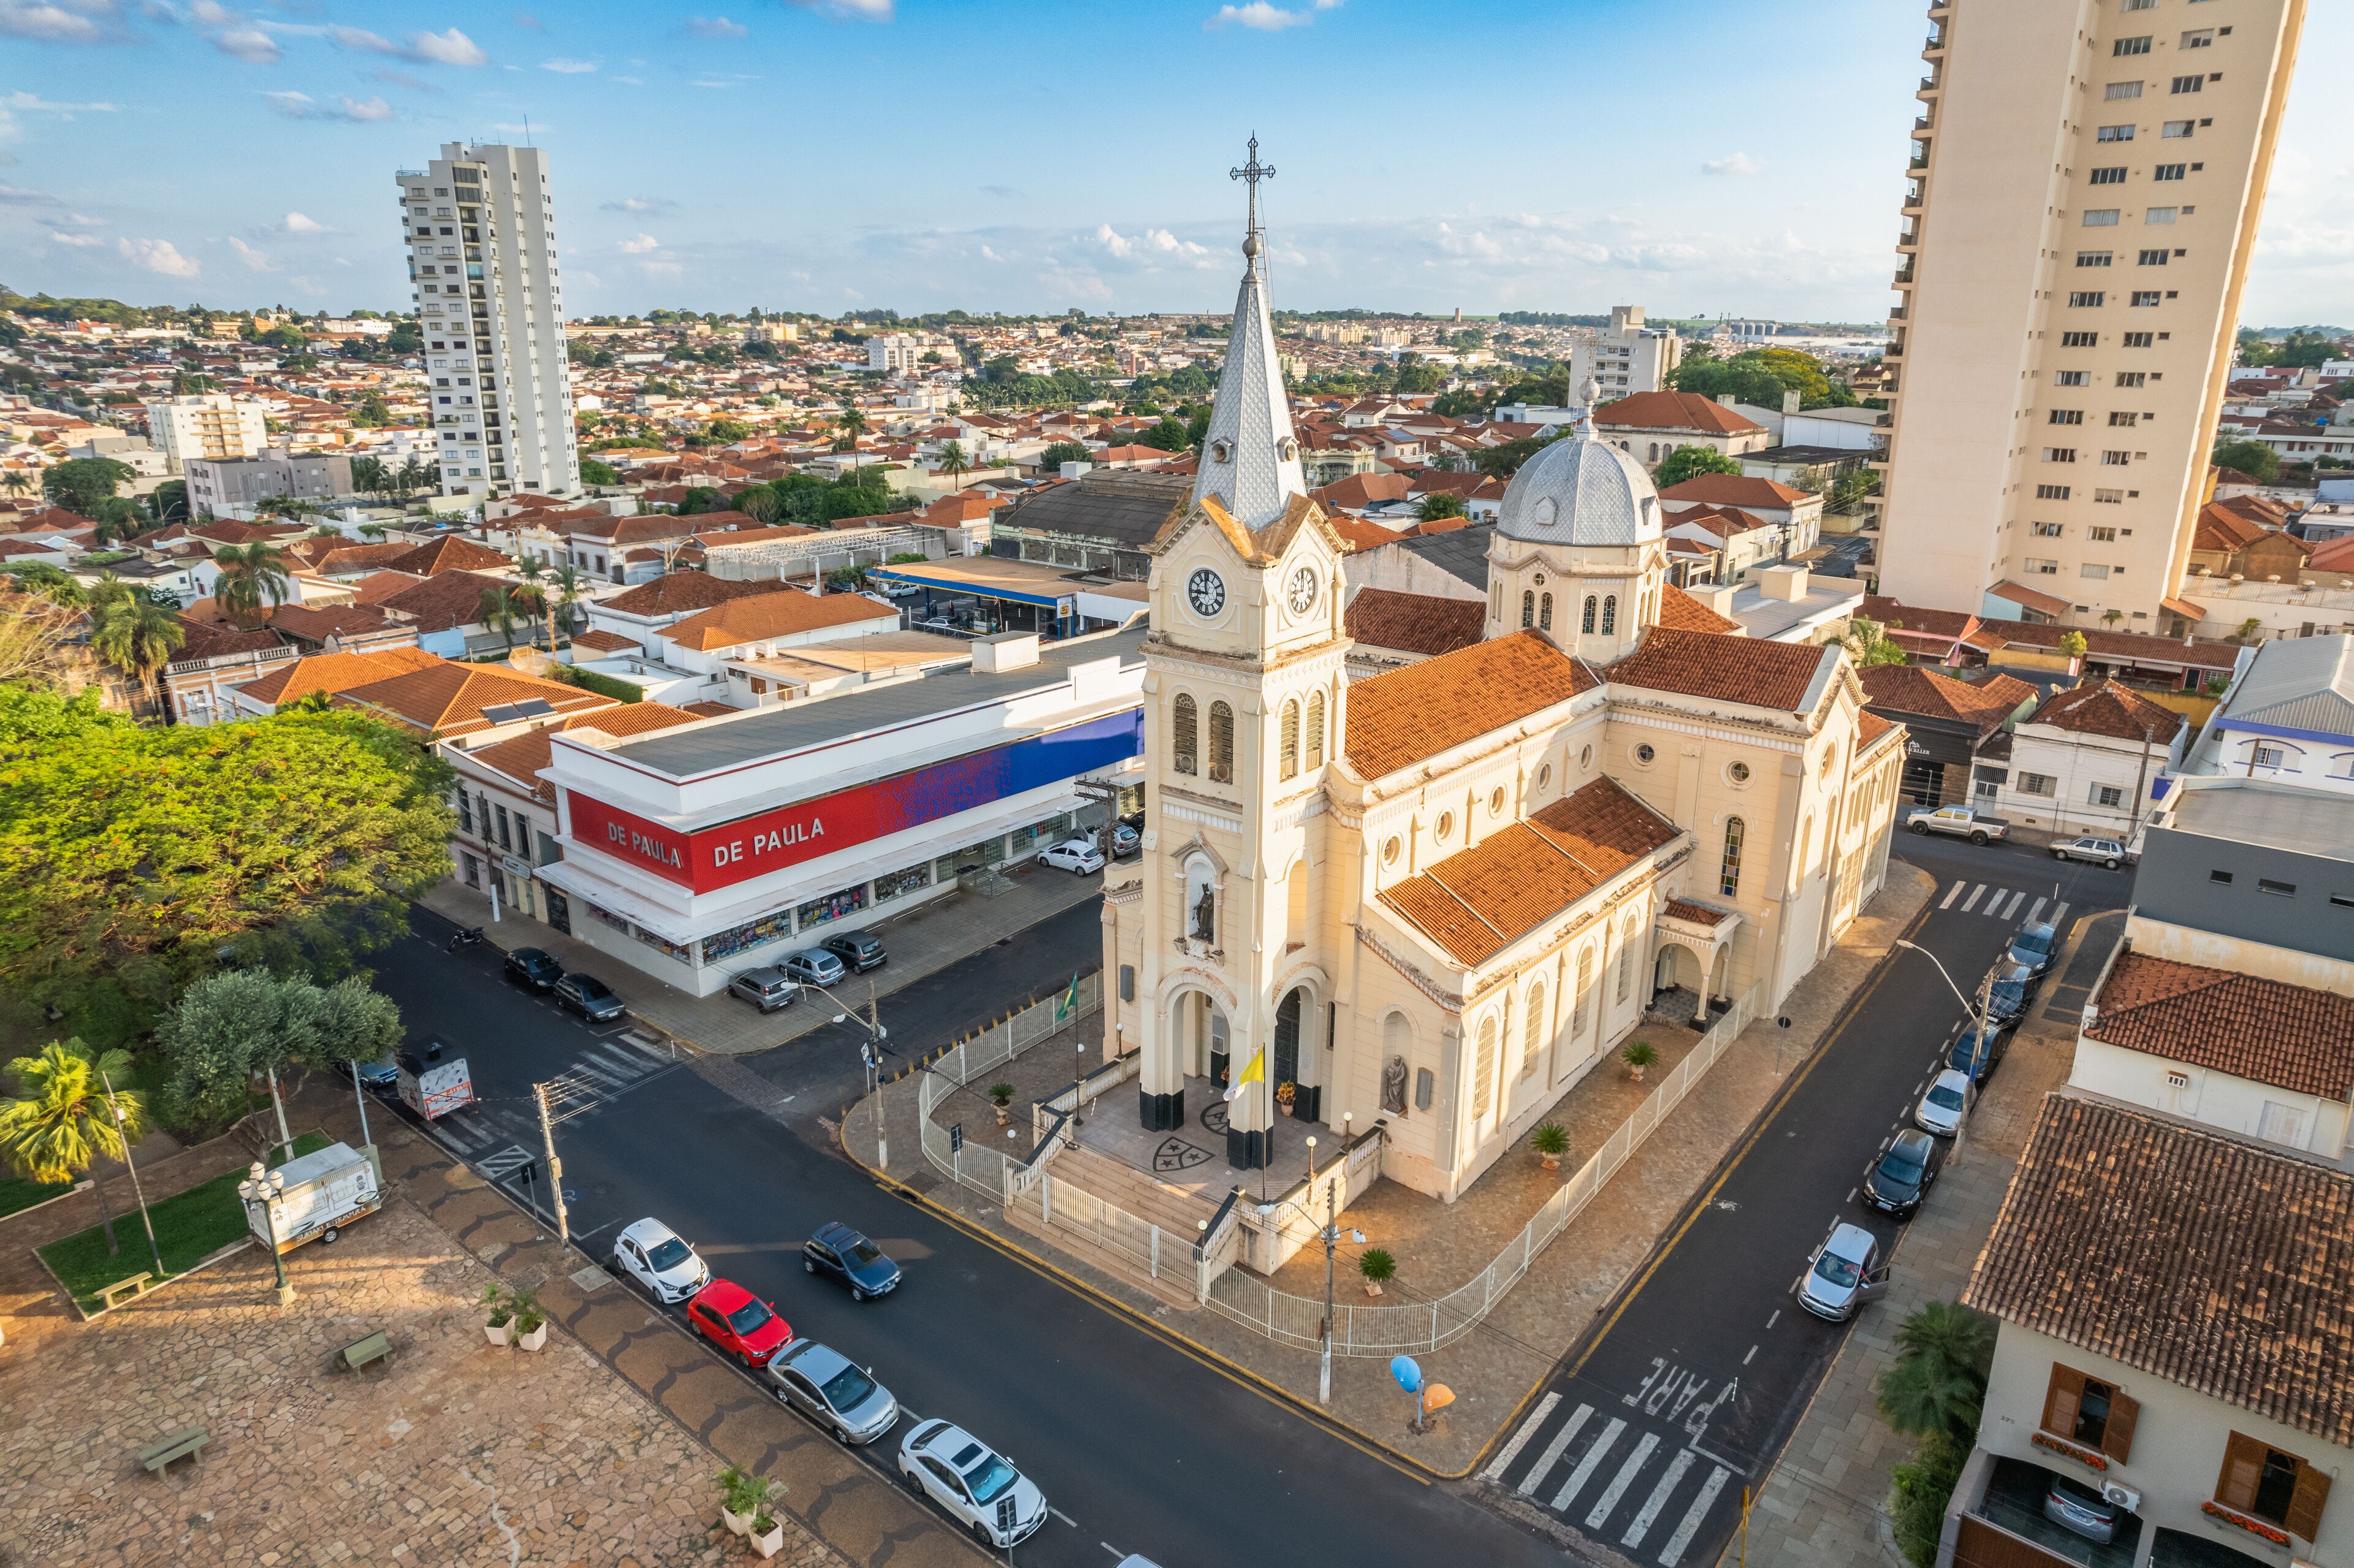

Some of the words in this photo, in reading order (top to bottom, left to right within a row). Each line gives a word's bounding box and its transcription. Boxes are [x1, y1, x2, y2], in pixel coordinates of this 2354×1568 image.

[608, 821, 627, 847] DE
[631, 831, 682, 869] PAULA
[715, 840, 743, 867] DE
[754, 818, 824, 855] PAULA
[297, 1225, 324, 1241] SUKIAKI
[333, 1206, 366, 1224] TEMPURA
[1621, 1357, 1734, 1436] PARE
